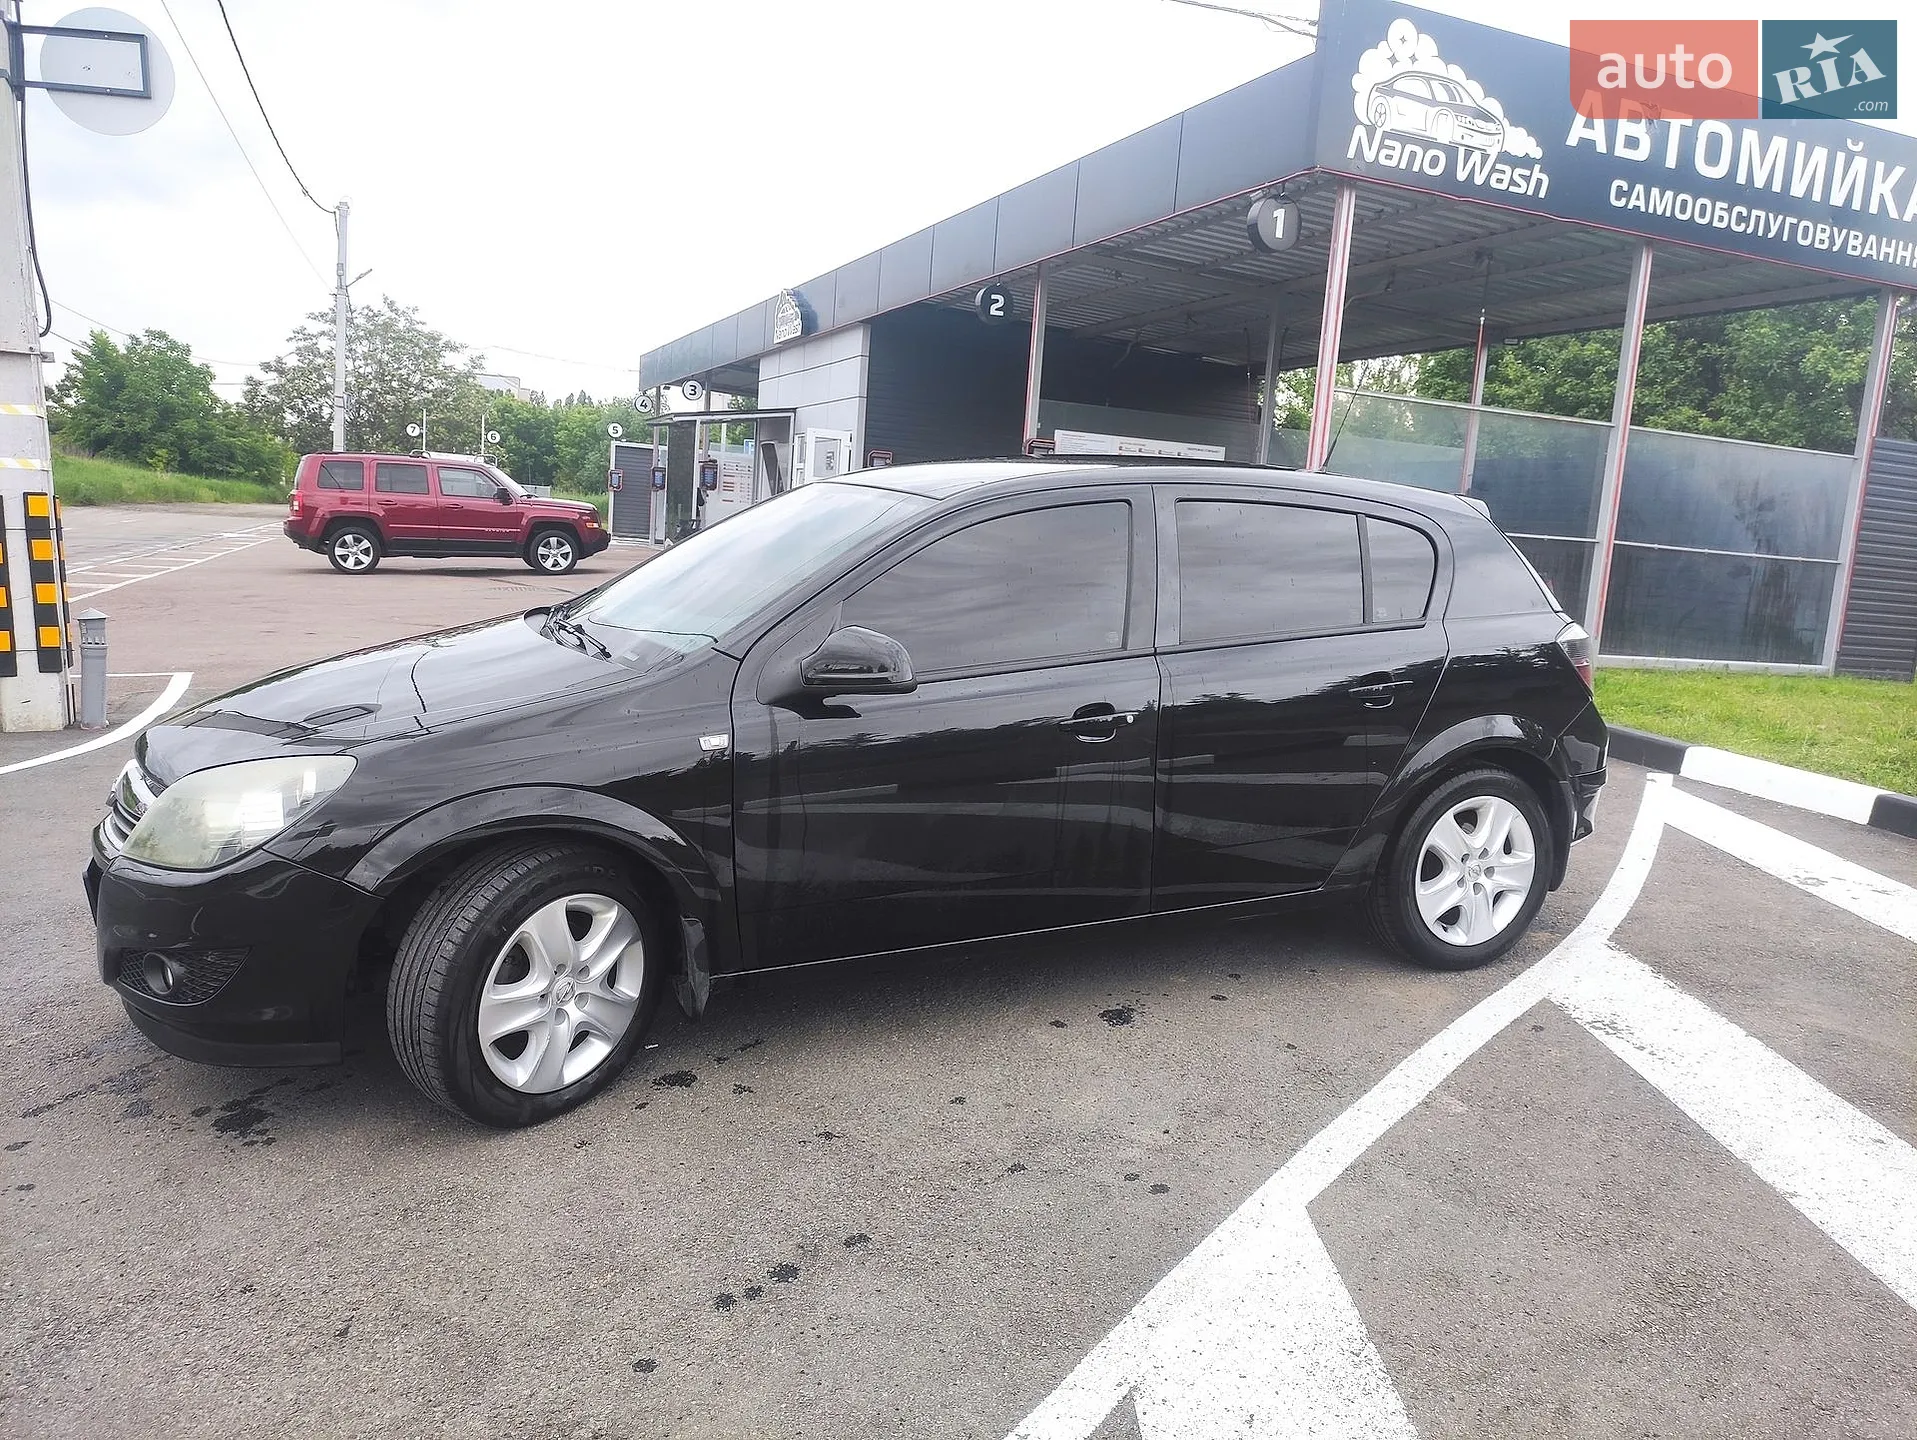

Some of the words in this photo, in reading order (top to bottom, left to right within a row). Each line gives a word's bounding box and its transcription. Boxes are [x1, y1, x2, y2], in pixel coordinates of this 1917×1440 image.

[1346, 124, 1447, 177] Nano
[1456, 146, 1550, 200] Wash
[1272, 207, 1287, 239] 1
[989, 294, 1005, 317] 2
[688, 384, 697, 396] 3
[639, 399, 648, 410] 4
[410, 425, 416, 434] 7
[612, 425, 619, 435] 5
[490, 432, 497, 441] 6
